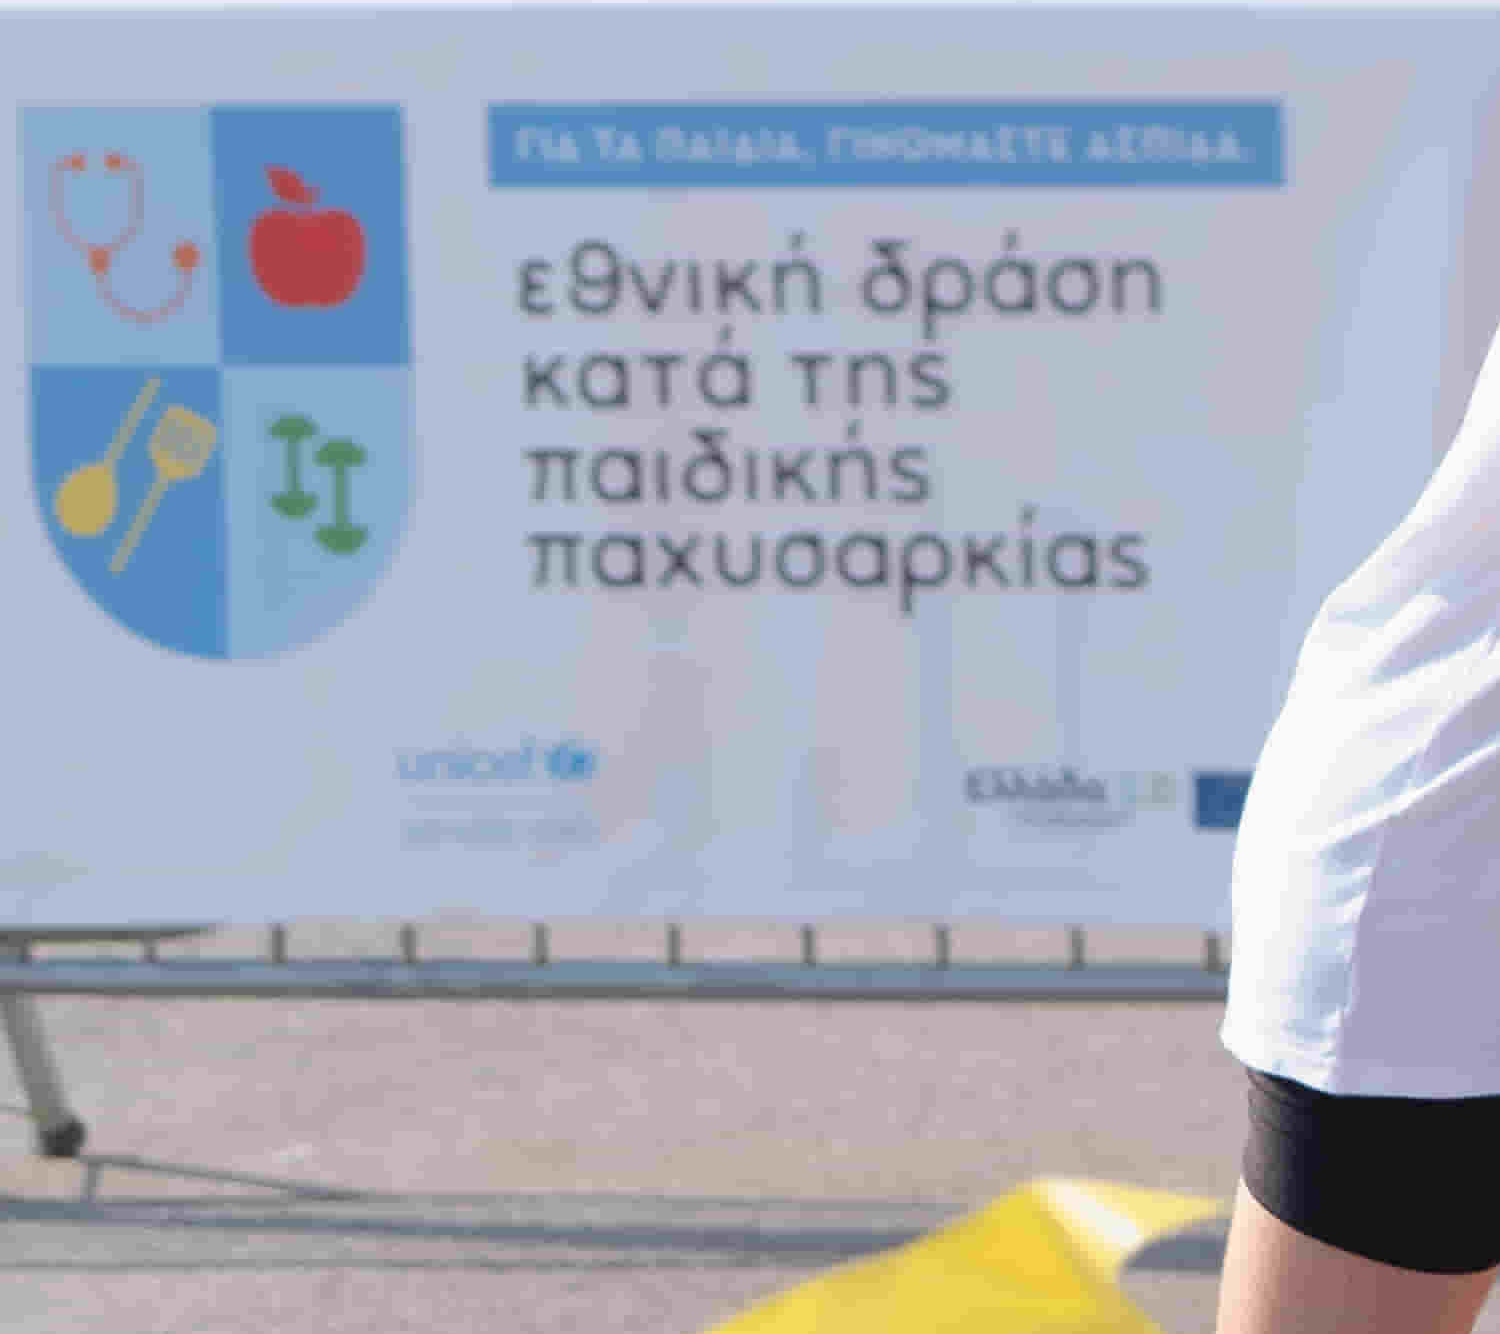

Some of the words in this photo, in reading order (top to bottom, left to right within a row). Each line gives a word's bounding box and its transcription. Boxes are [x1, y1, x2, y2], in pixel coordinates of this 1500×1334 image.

[516, 230, 822, 315] εθνική
[859, 230, 1160, 341] δράση
[522, 324, 751, 410] κατά
[789, 351, 951, 409] της
[524, 418, 931, 504] παιδικής
[526, 505, 1151, 615] παχυσαρκίας
